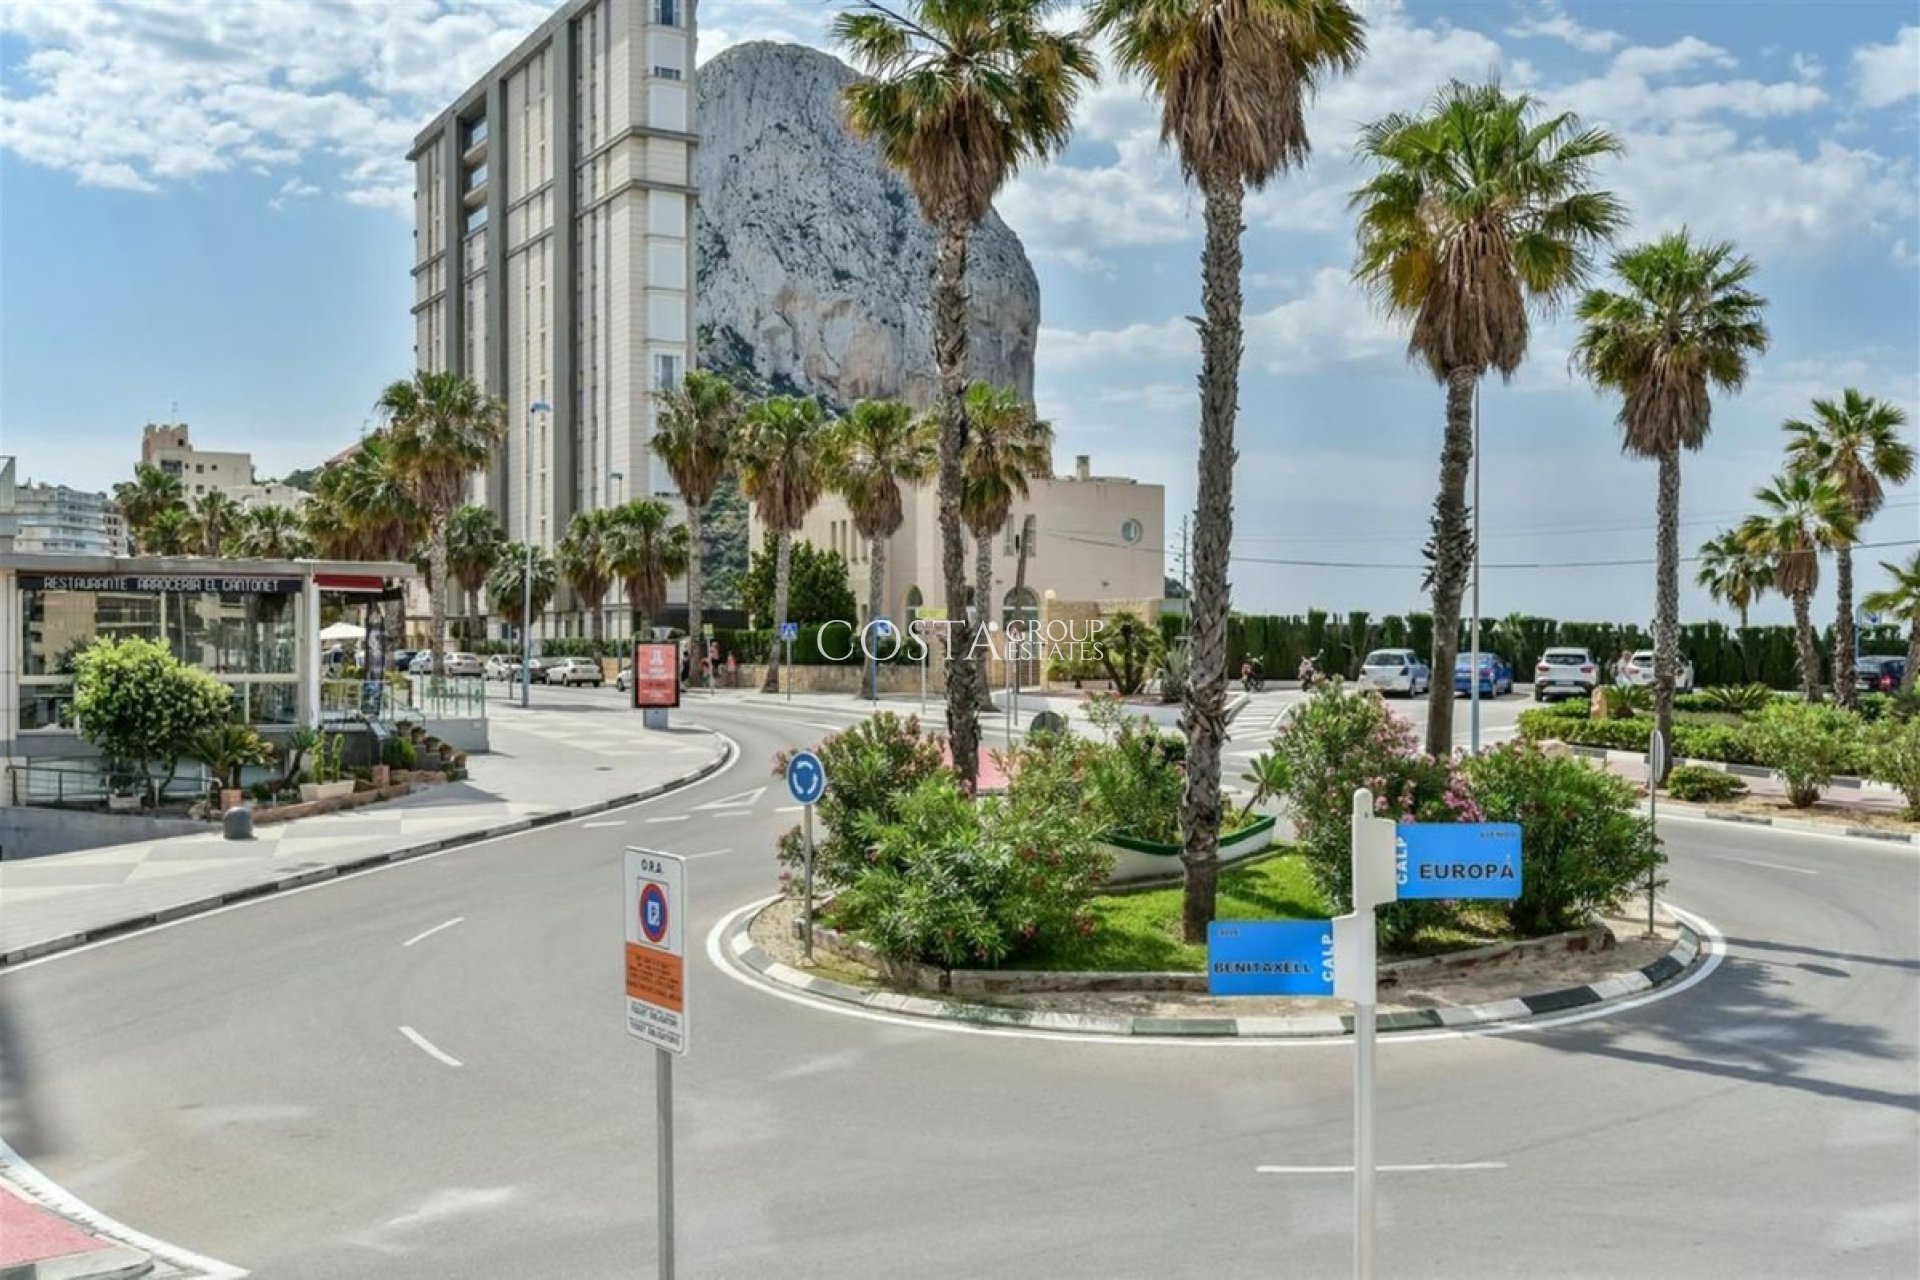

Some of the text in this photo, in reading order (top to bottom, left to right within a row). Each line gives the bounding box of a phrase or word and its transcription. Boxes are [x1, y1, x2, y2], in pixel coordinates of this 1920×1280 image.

[43, 576, 127, 590] RESTAURANTE
[205, 578, 218, 590] EL
[1396, 836, 1408, 885] CALP
[1419, 864, 1514, 879] EUROPA
[1322, 934, 1333, 982] CALP
[1214, 962, 1313, 974] BENITAXELL
